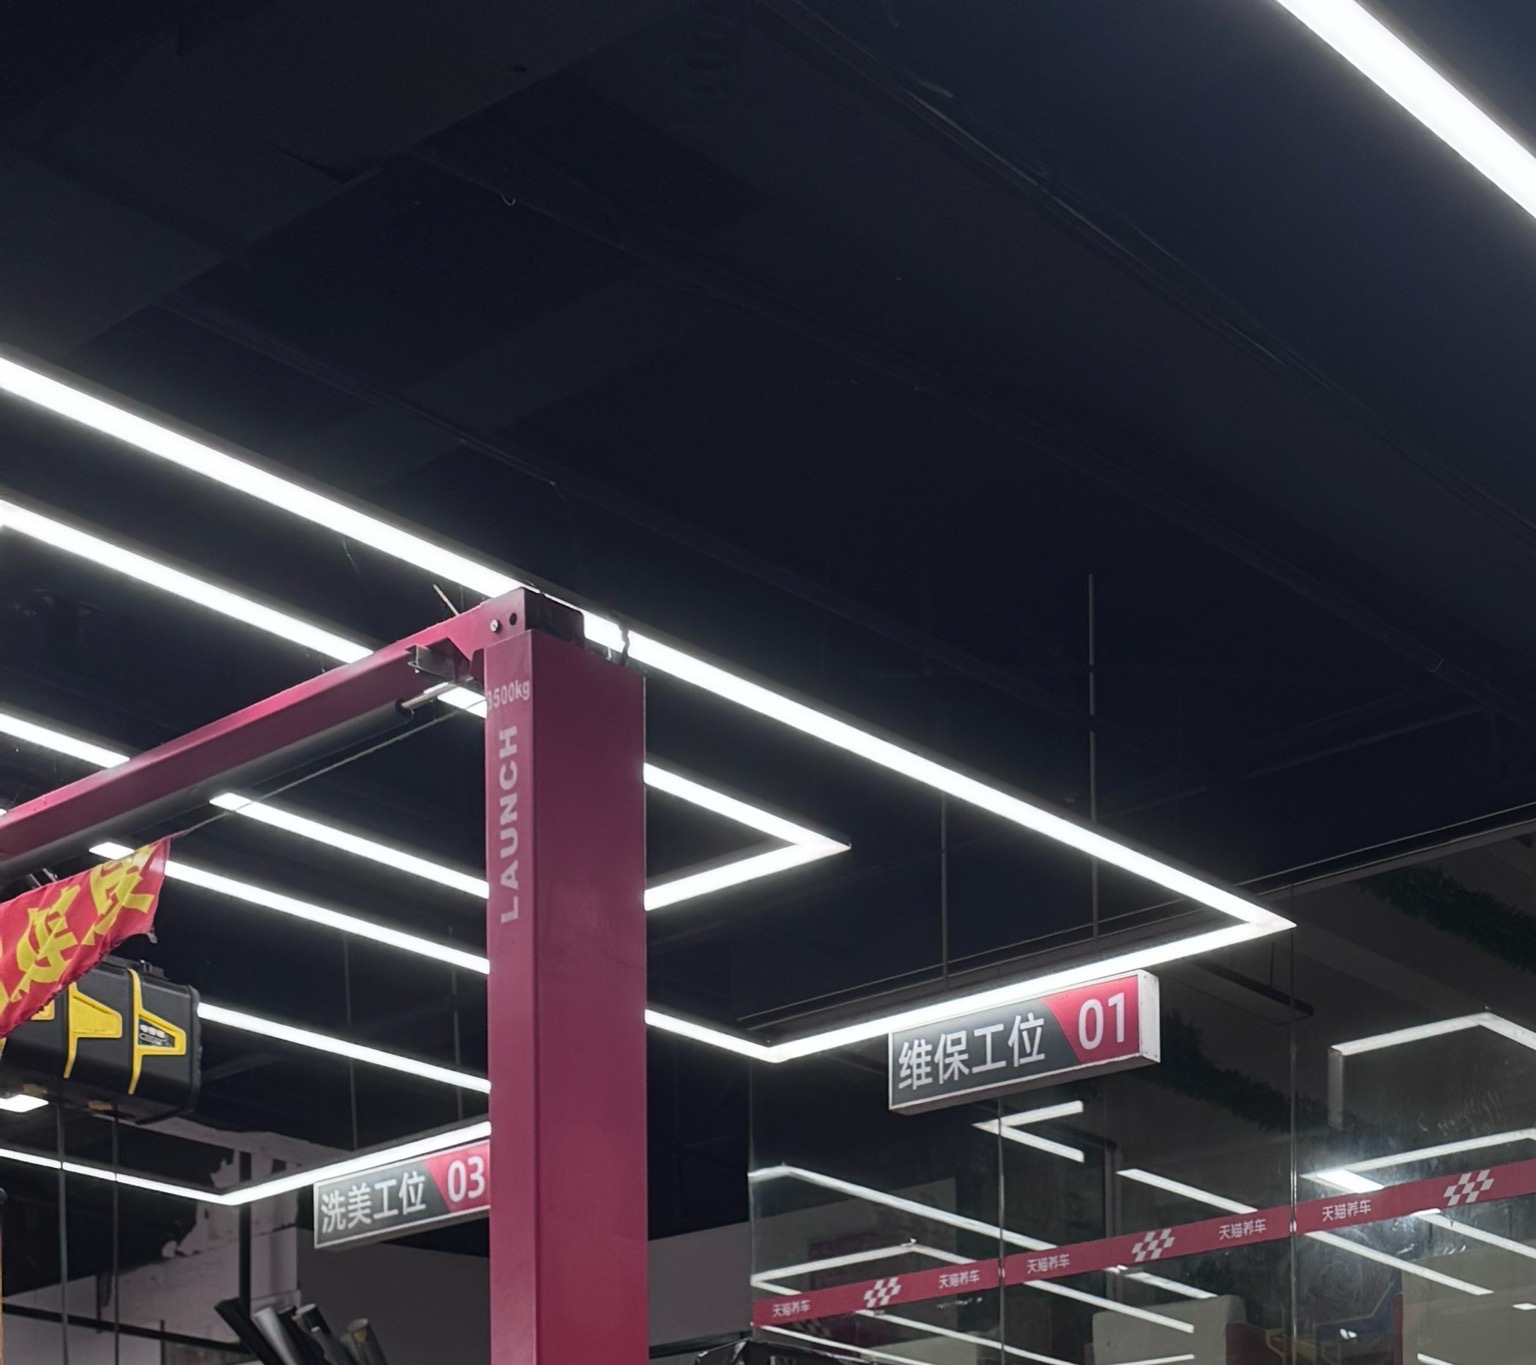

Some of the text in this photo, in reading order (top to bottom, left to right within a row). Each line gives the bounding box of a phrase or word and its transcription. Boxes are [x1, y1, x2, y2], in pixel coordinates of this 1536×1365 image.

[500, 725, 519, 924] LAUNCH
[899, 992, 1125, 1090] 维保工位 01
[320, 1156, 485, 1233] 洗美工位 03
[1322, 1200, 1371, 1222] 天猫养车
[1219, 1218, 1266, 1240] 天猫养车
[1027, 1254, 1070, 1274] 天猫养车
[939, 1270, 980, 1290] 天猫养车
[772, 1300, 810, 1318] 天猫养车
